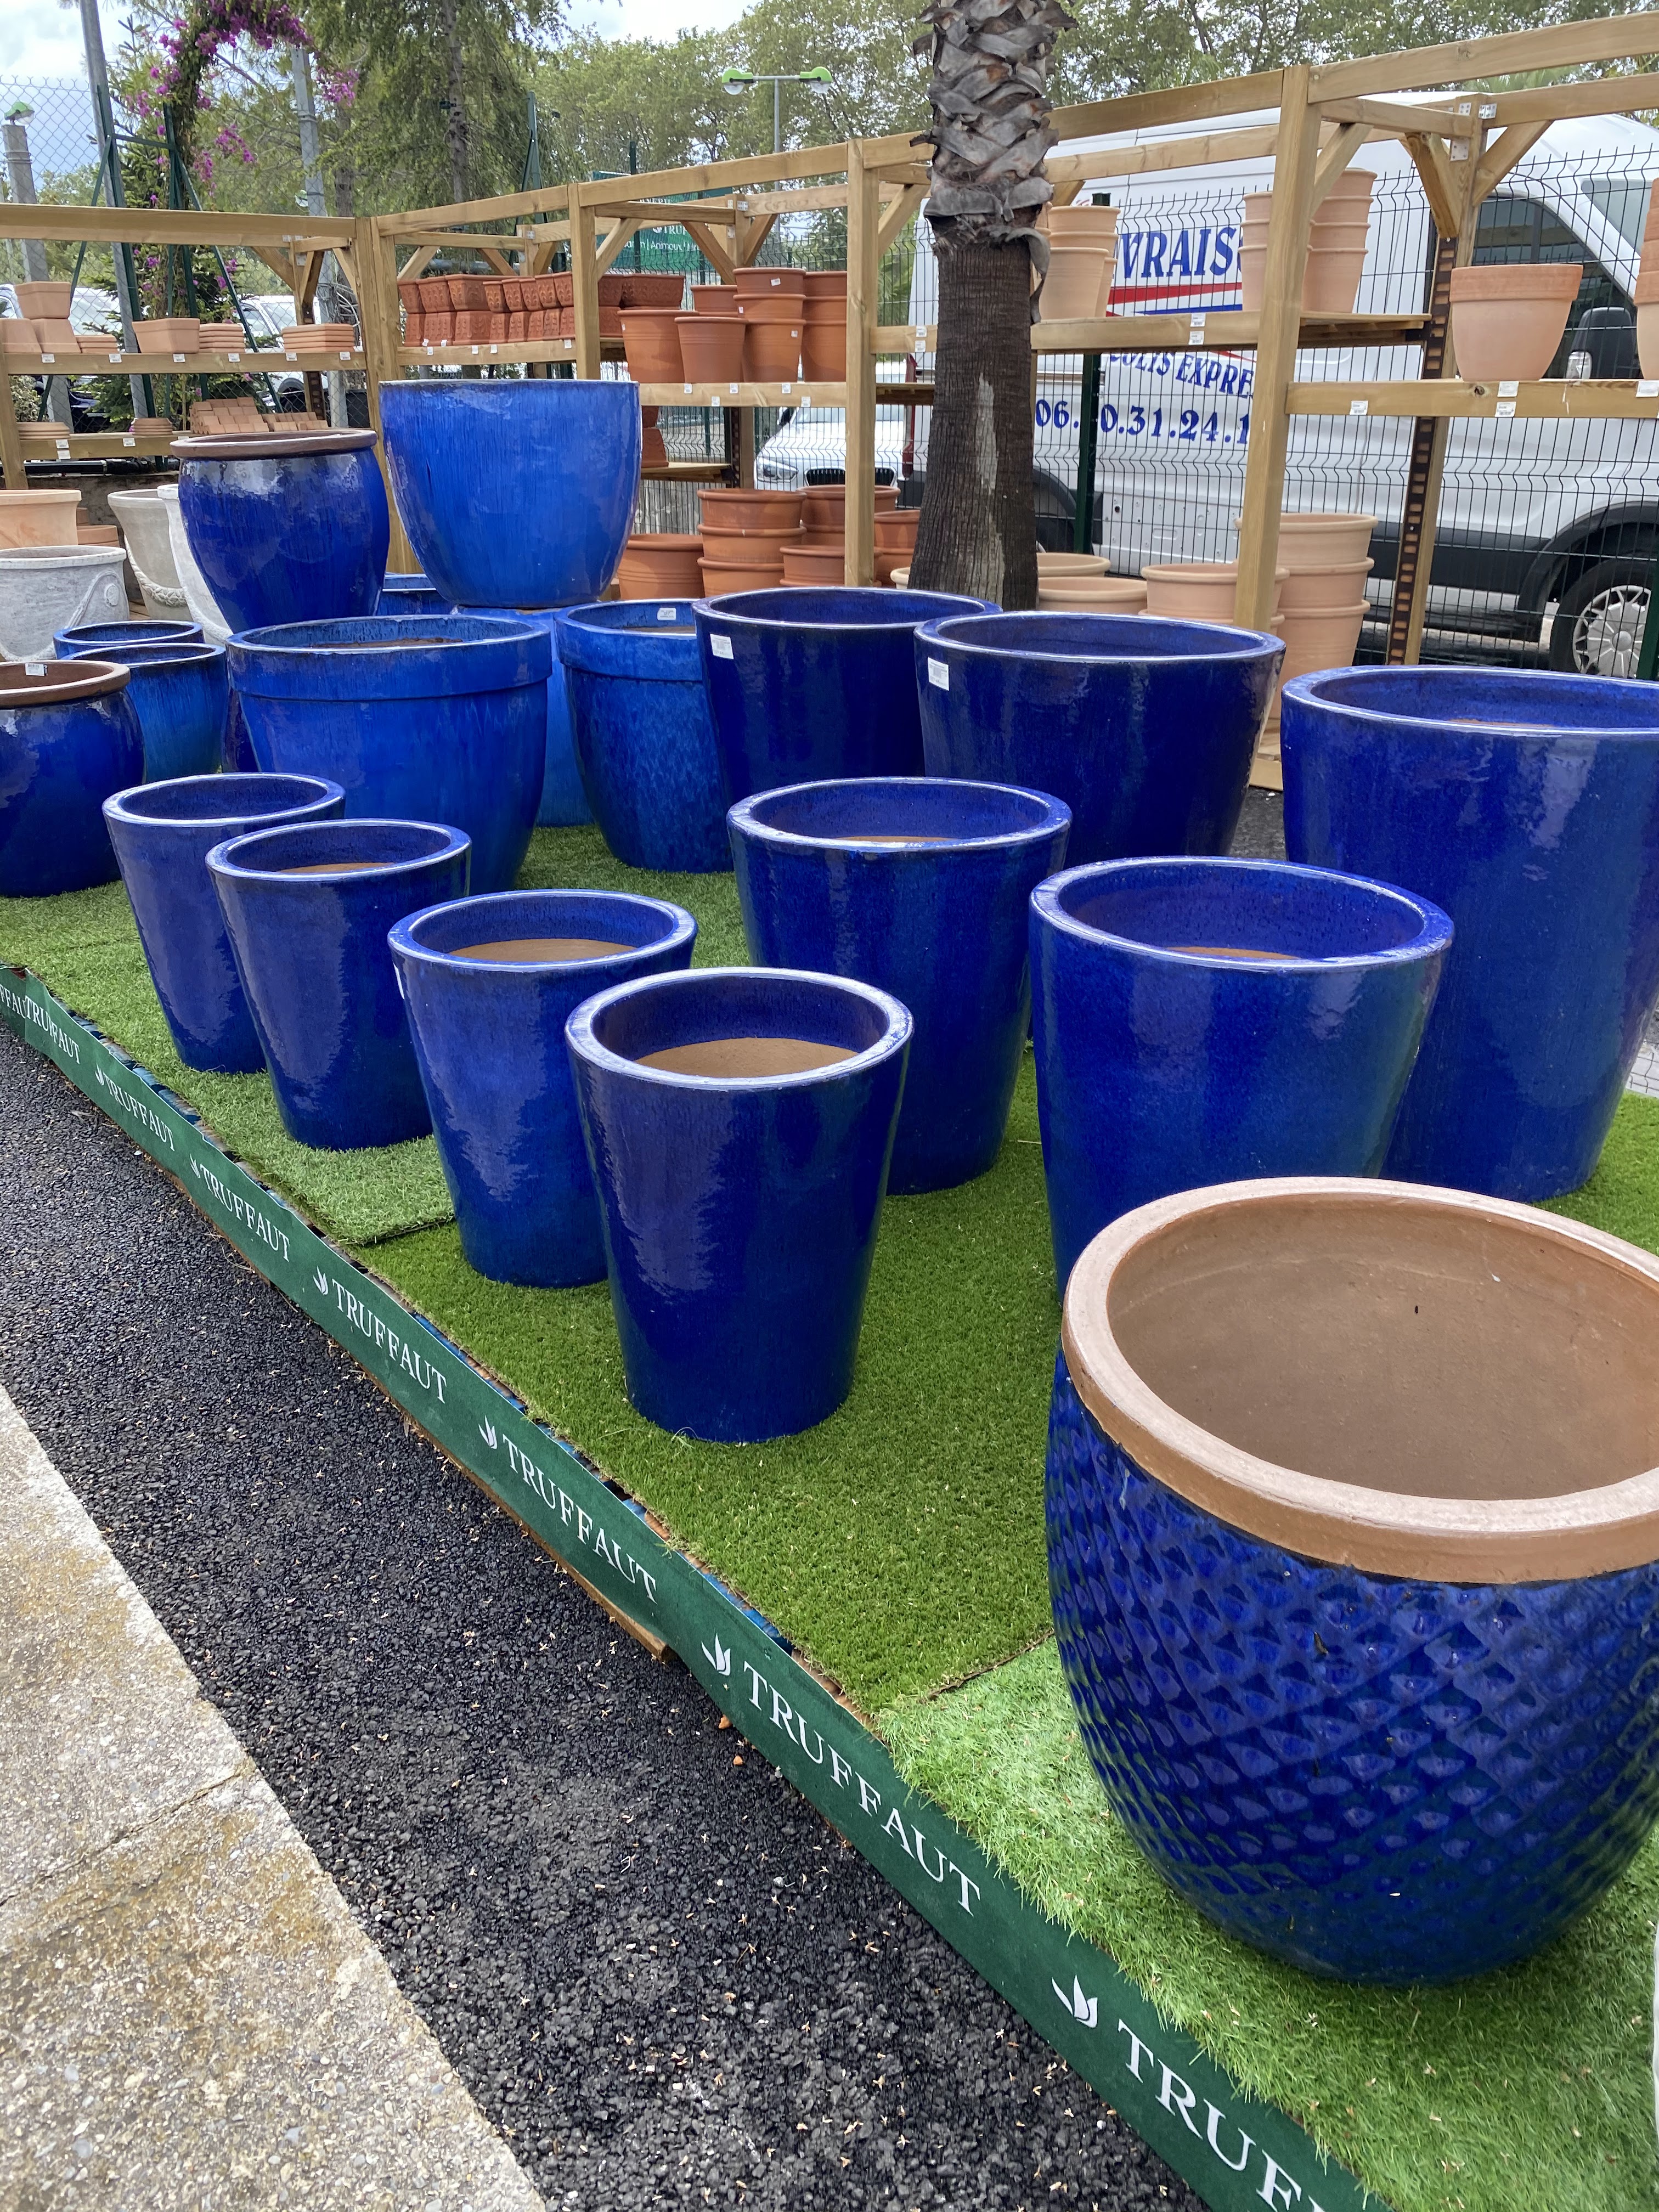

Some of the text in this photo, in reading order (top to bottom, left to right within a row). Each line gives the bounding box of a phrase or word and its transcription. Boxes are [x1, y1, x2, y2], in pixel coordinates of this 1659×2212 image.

[1113, 226, 1243, 279] VRAIS
[1176, 354, 1254, 399] EXPRE
[103, 1072, 176, 1152] TRUFFAUT
[200, 1163, 290, 1262] TRUFFAUT
[331, 1278, 447, 1404] TRUFFAUT
[503, 1434, 657, 1605] TRUFFAUT
[743, 1661, 981, 1917] TRUFFAUT
[1117, 2018, 1325, 2212] TRUF
